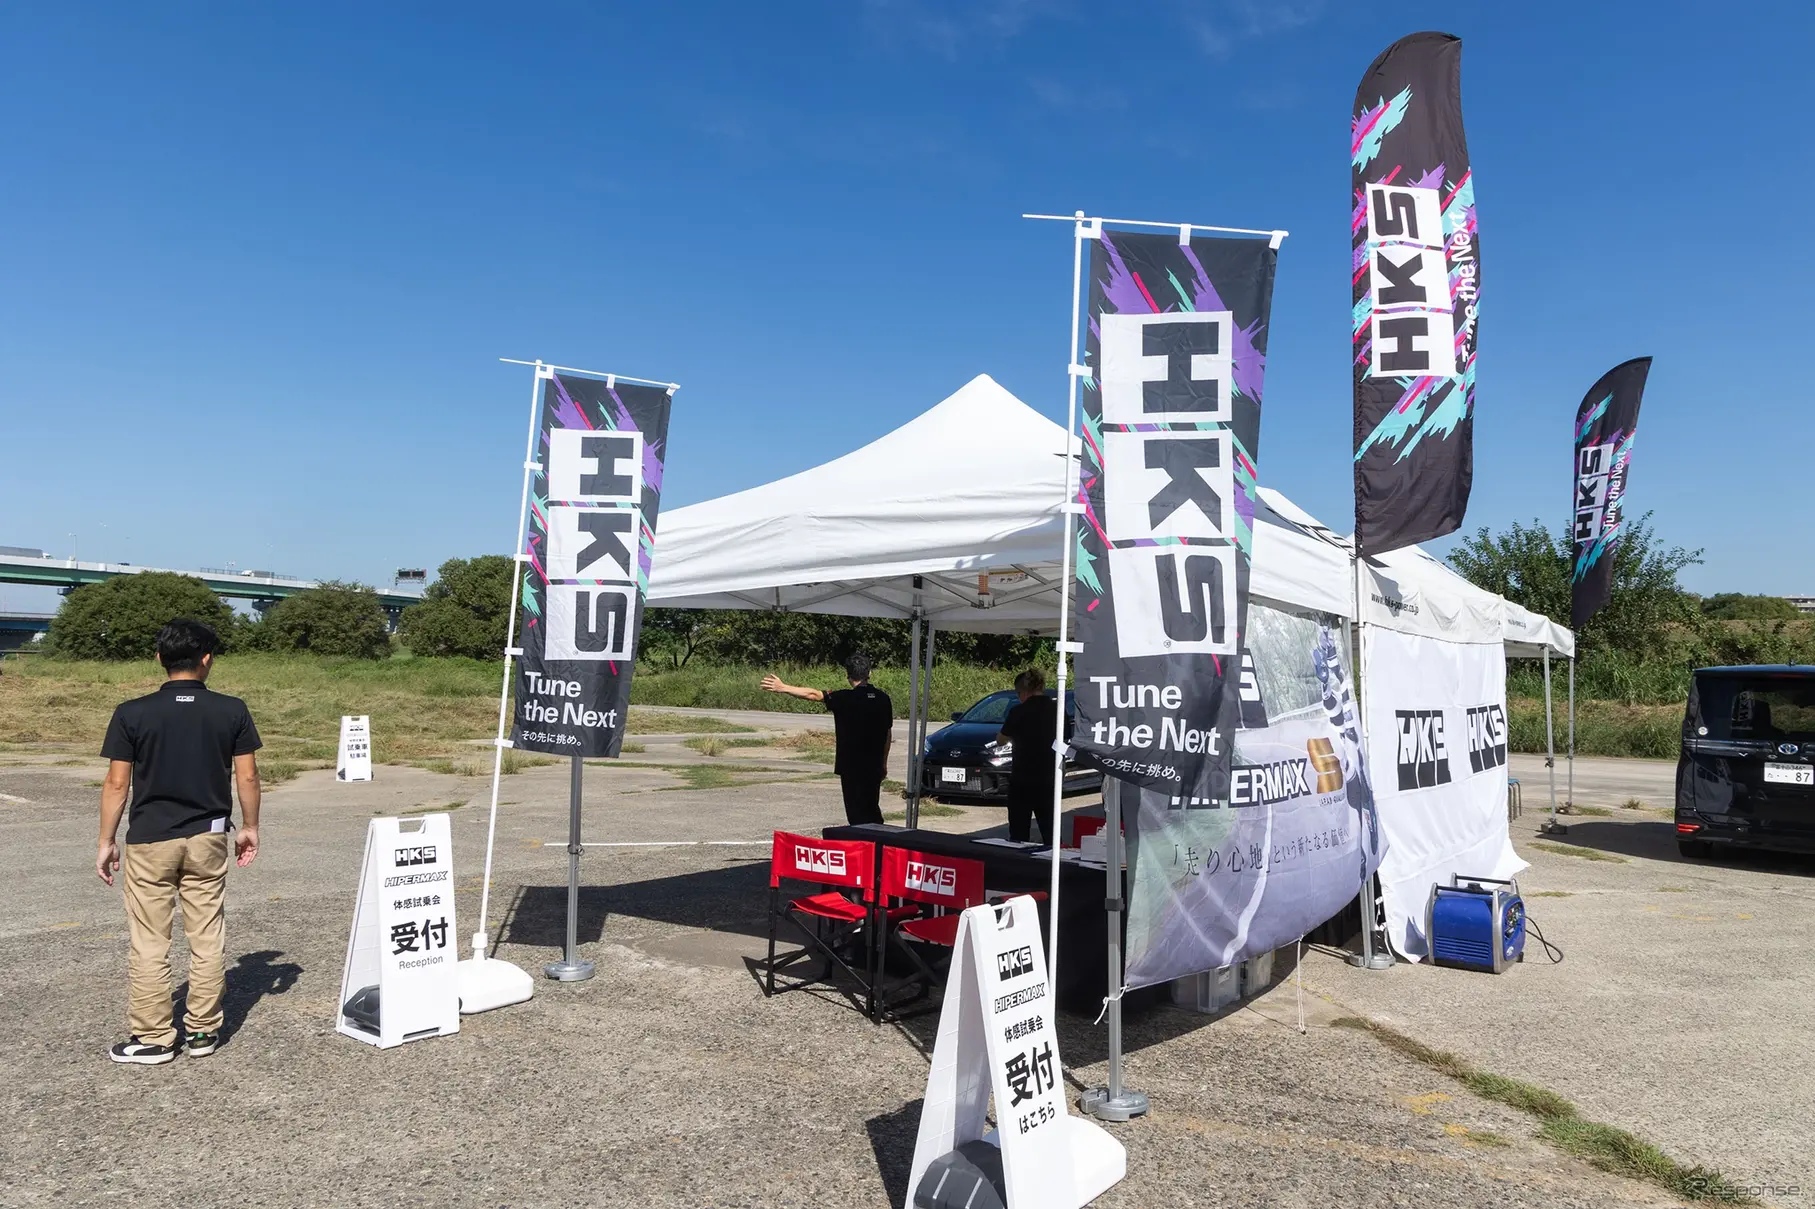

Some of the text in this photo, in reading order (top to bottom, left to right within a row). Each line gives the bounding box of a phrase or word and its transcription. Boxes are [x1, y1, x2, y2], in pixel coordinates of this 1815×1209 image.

[1449, 211, 1475, 262] Next
[1369, 187, 1434, 373] HKS
[1456, 263, 1477, 302] the
[1611, 450, 1627, 480] Next
[1136, 318, 1228, 648] HKS
[1575, 446, 1605, 541] HKS
[1608, 479, 1622, 501] the
[570, 434, 637, 656] HKS
[525, 671, 582, 698] Tune
[1090, 676, 1182, 710] Tune
[524, 700, 617, 728] the Next
[521, 730, 582, 747] その先に挑め。
[1091, 717, 1221, 756] the Next
[1466, 703, 1506, 774] HKS
[1168, 758, 1312, 810] PERMAX
[395, 846, 437, 867] HKS
[795, 846, 845, 873] HKS
[384, 871, 448, 888] HIPERMAX
[906, 861, 955, 894] HKS
[393, 895, 441, 910] 体感試乗会
[390, 916, 449, 956] 受付
[399, 956, 444, 970] Reception
[997, 945, 1034, 981] HKS
[995, 983, 1045, 1014] HIPERMAX
[1004, 1015, 1044, 1043] 体感試乗会
[1005, 1041, 1055, 1108] 受付
[1019, 1101, 1056, 1135] はこちら
